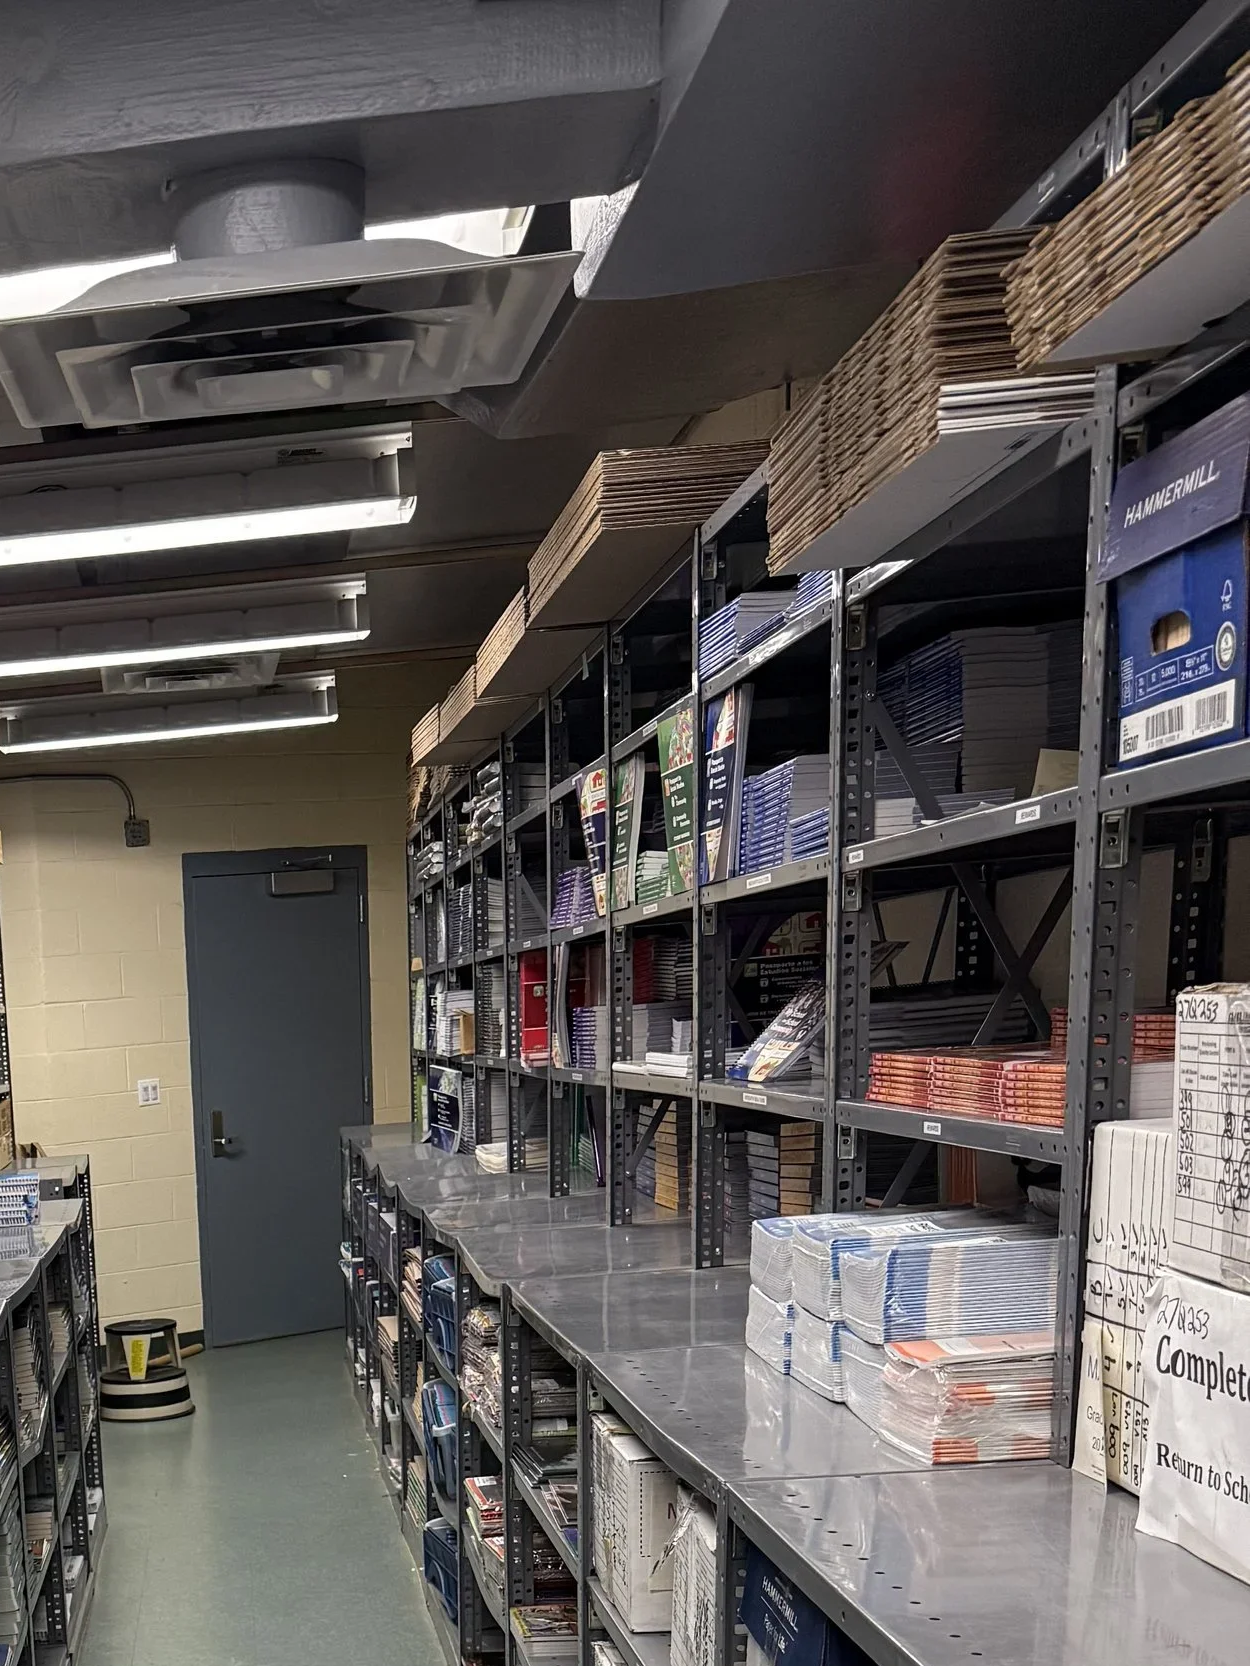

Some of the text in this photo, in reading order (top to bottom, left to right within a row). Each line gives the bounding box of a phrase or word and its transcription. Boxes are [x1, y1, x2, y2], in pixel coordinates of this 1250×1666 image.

[1124, 460, 1216, 528] HAMMERMILL
[1156, 1334, 1250, 1403] Complet
[1156, 1442, 1250, 1505] Return to Sch
[762, 1575, 799, 1633] HAMMERMILL
